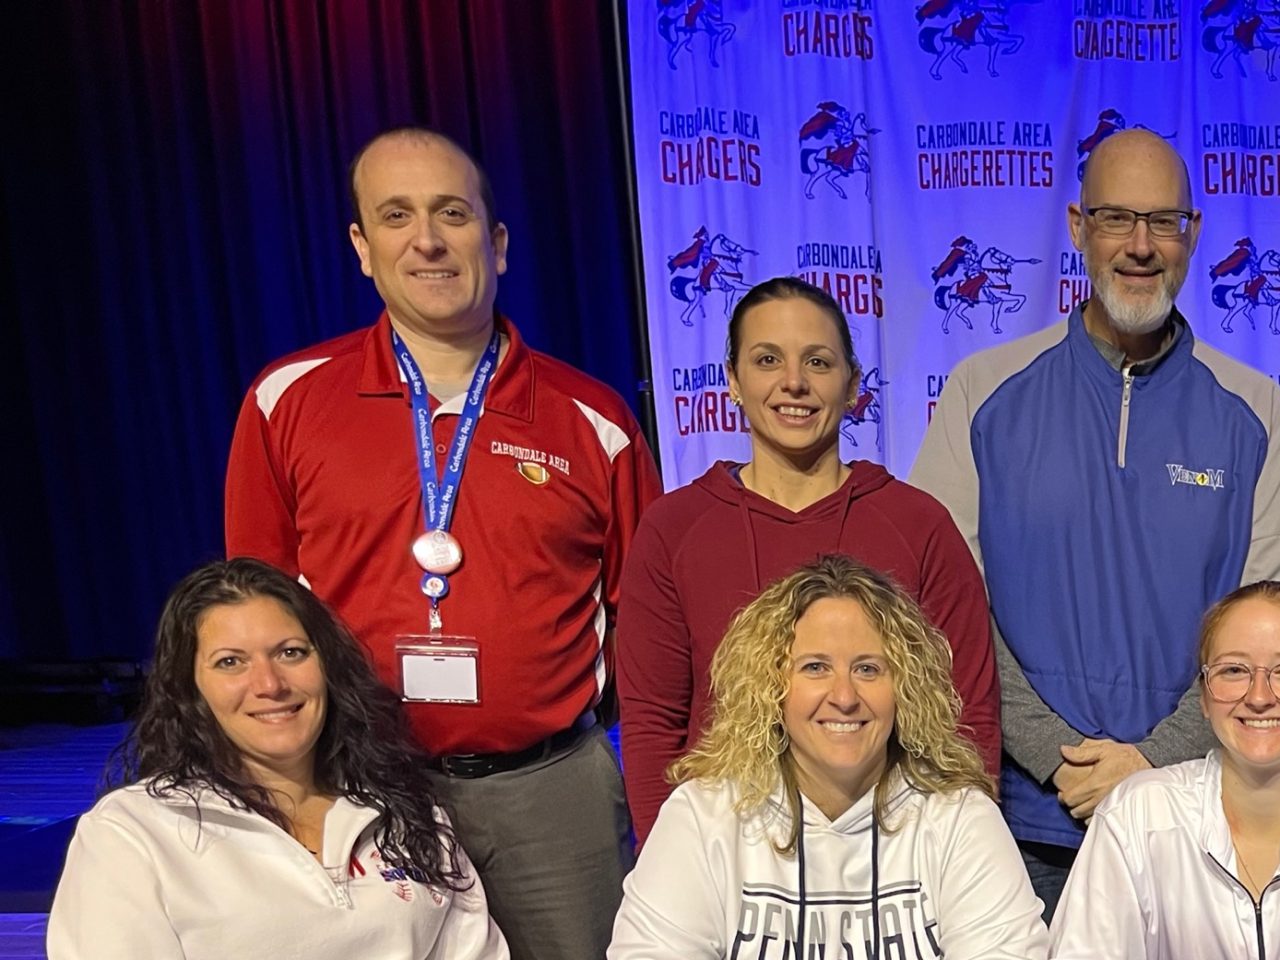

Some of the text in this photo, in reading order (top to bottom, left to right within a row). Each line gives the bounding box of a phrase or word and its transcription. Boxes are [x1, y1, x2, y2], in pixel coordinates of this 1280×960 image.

[916, 121, 1053, 149] CARBONDALE AREA
[918, 149, 1053, 190] CHARGERETTES
[491, 440, 570, 476] CARBONDALE AREA
